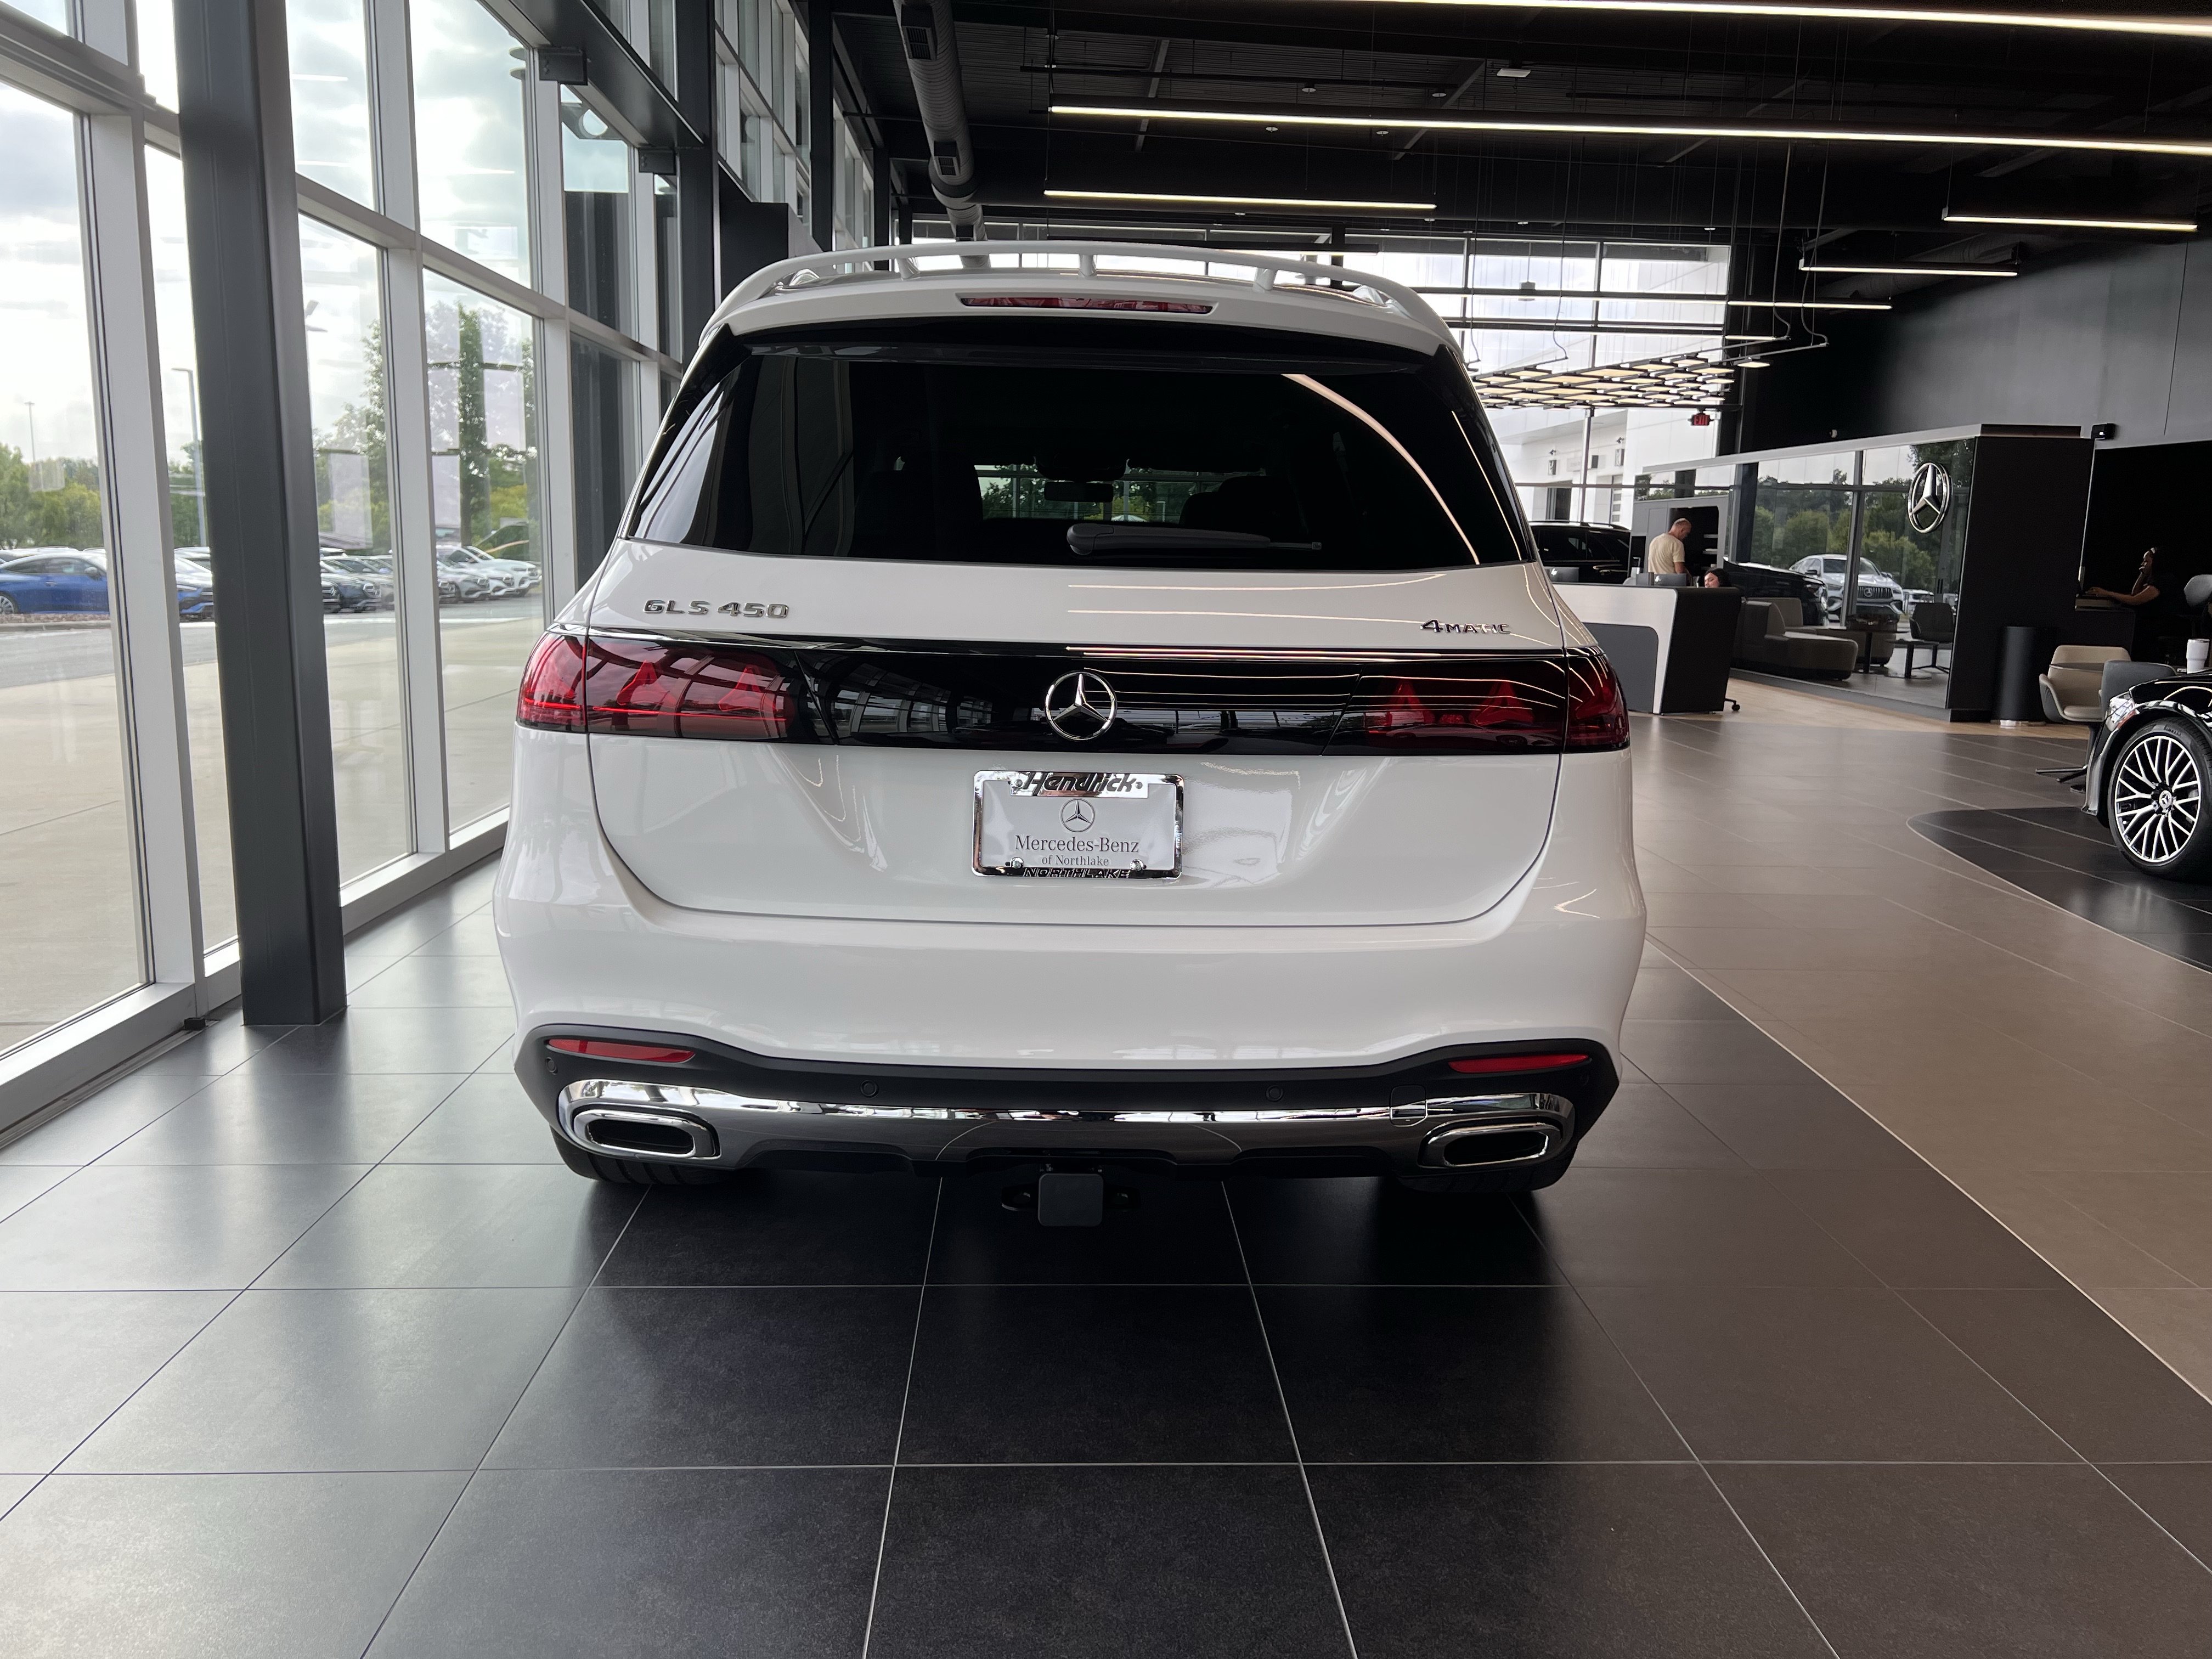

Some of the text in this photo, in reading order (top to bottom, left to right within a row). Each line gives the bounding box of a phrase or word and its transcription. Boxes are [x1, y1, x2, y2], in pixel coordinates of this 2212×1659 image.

[642, 600, 789, 619] GLS 450
[1420, 619, 1511, 635] 4MATIC
[1022, 771, 1137, 796] Hendrick
[1014, 834, 1139, 853] Mercedes-Benz
[1041, 854, 1110, 866] of Northlake
[1022, 867, 1131, 878] NORTHLAKE
